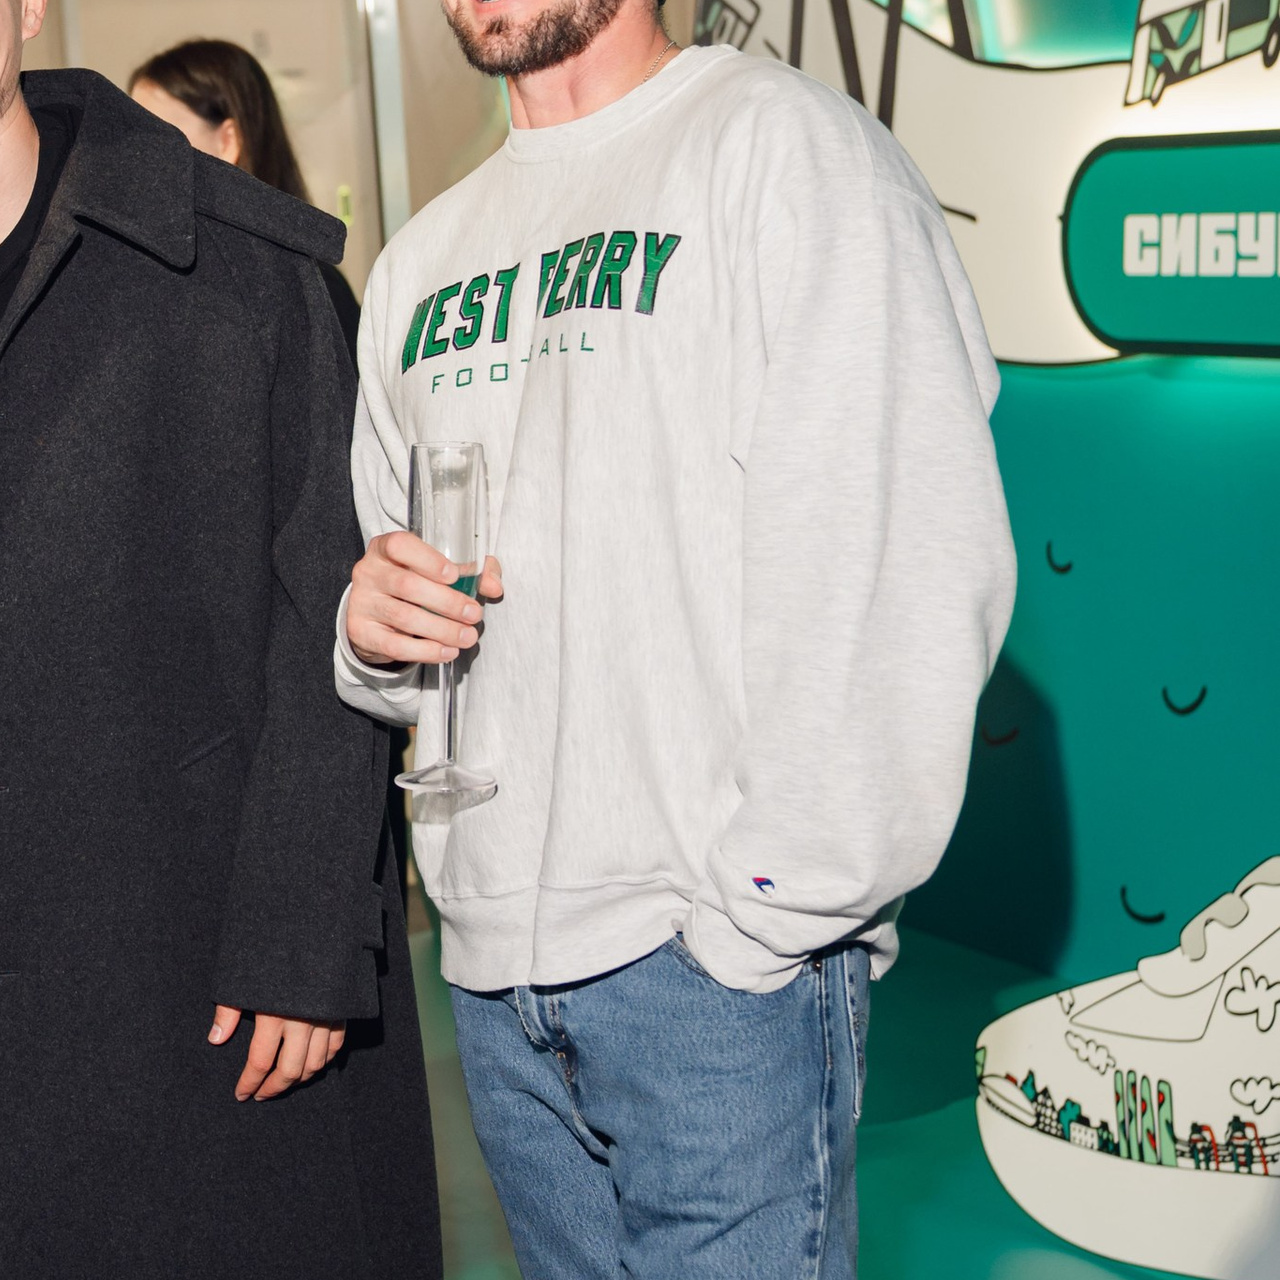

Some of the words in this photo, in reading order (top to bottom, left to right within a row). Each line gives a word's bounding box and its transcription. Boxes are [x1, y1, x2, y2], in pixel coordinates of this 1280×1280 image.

[1123, 212, 1280, 277] СИБУ
[401, 262, 521, 375] WEST
[431, 331, 594, 393] FOOALL
